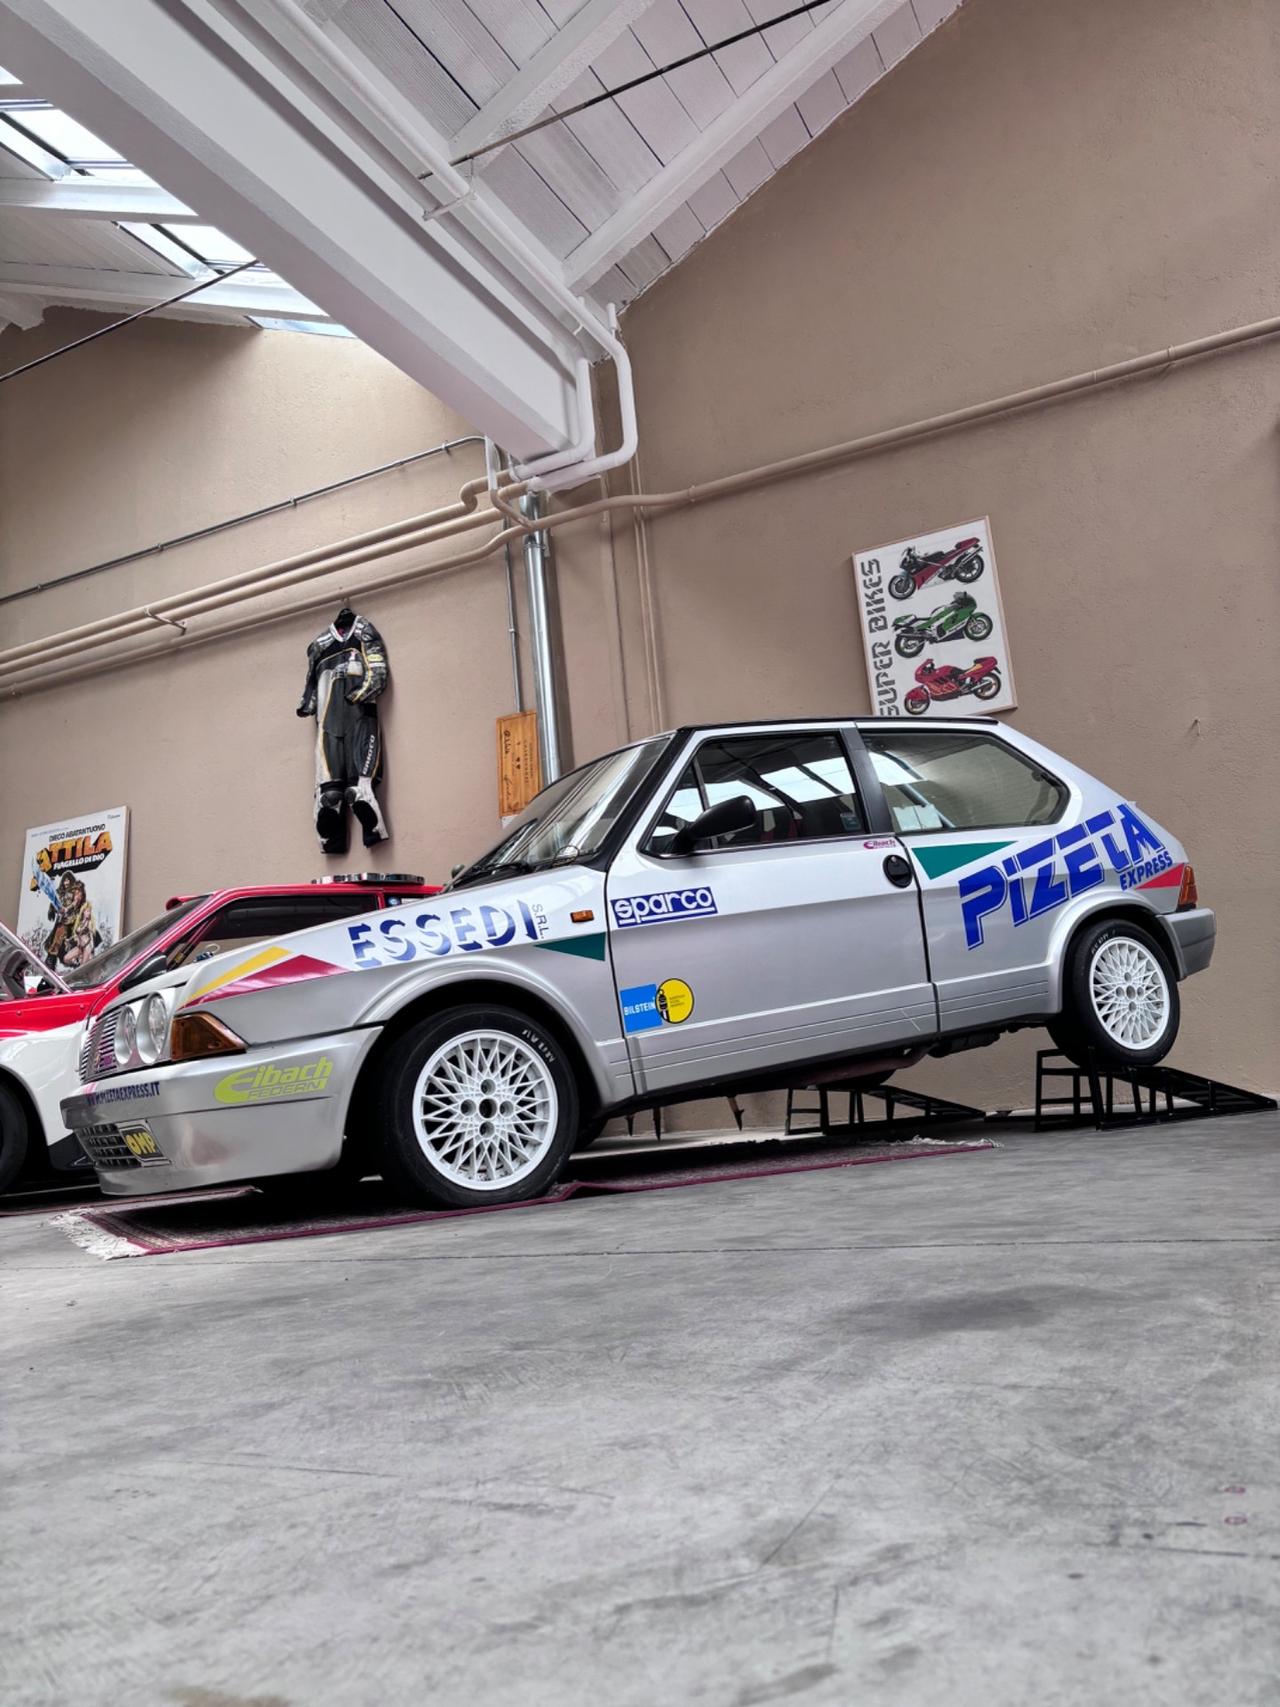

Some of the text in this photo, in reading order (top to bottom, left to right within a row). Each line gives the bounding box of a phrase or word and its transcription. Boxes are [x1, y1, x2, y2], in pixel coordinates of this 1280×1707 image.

[861, 558, 900, 716] SUPER BIKES
[36, 831, 112, 873] ATTILA
[49, 832, 66, 842] DIEGO
[1119, 850, 1173, 891] EXPRESS
[614, 888, 713, 924] sparco
[347, 899, 549, 969] ESSEDI S.R.L.
[623, 1001, 656, 1016] BILSTEIN
[214, 1056, 333, 1104] Eibach
[125, 1131, 156, 1155] OMP
